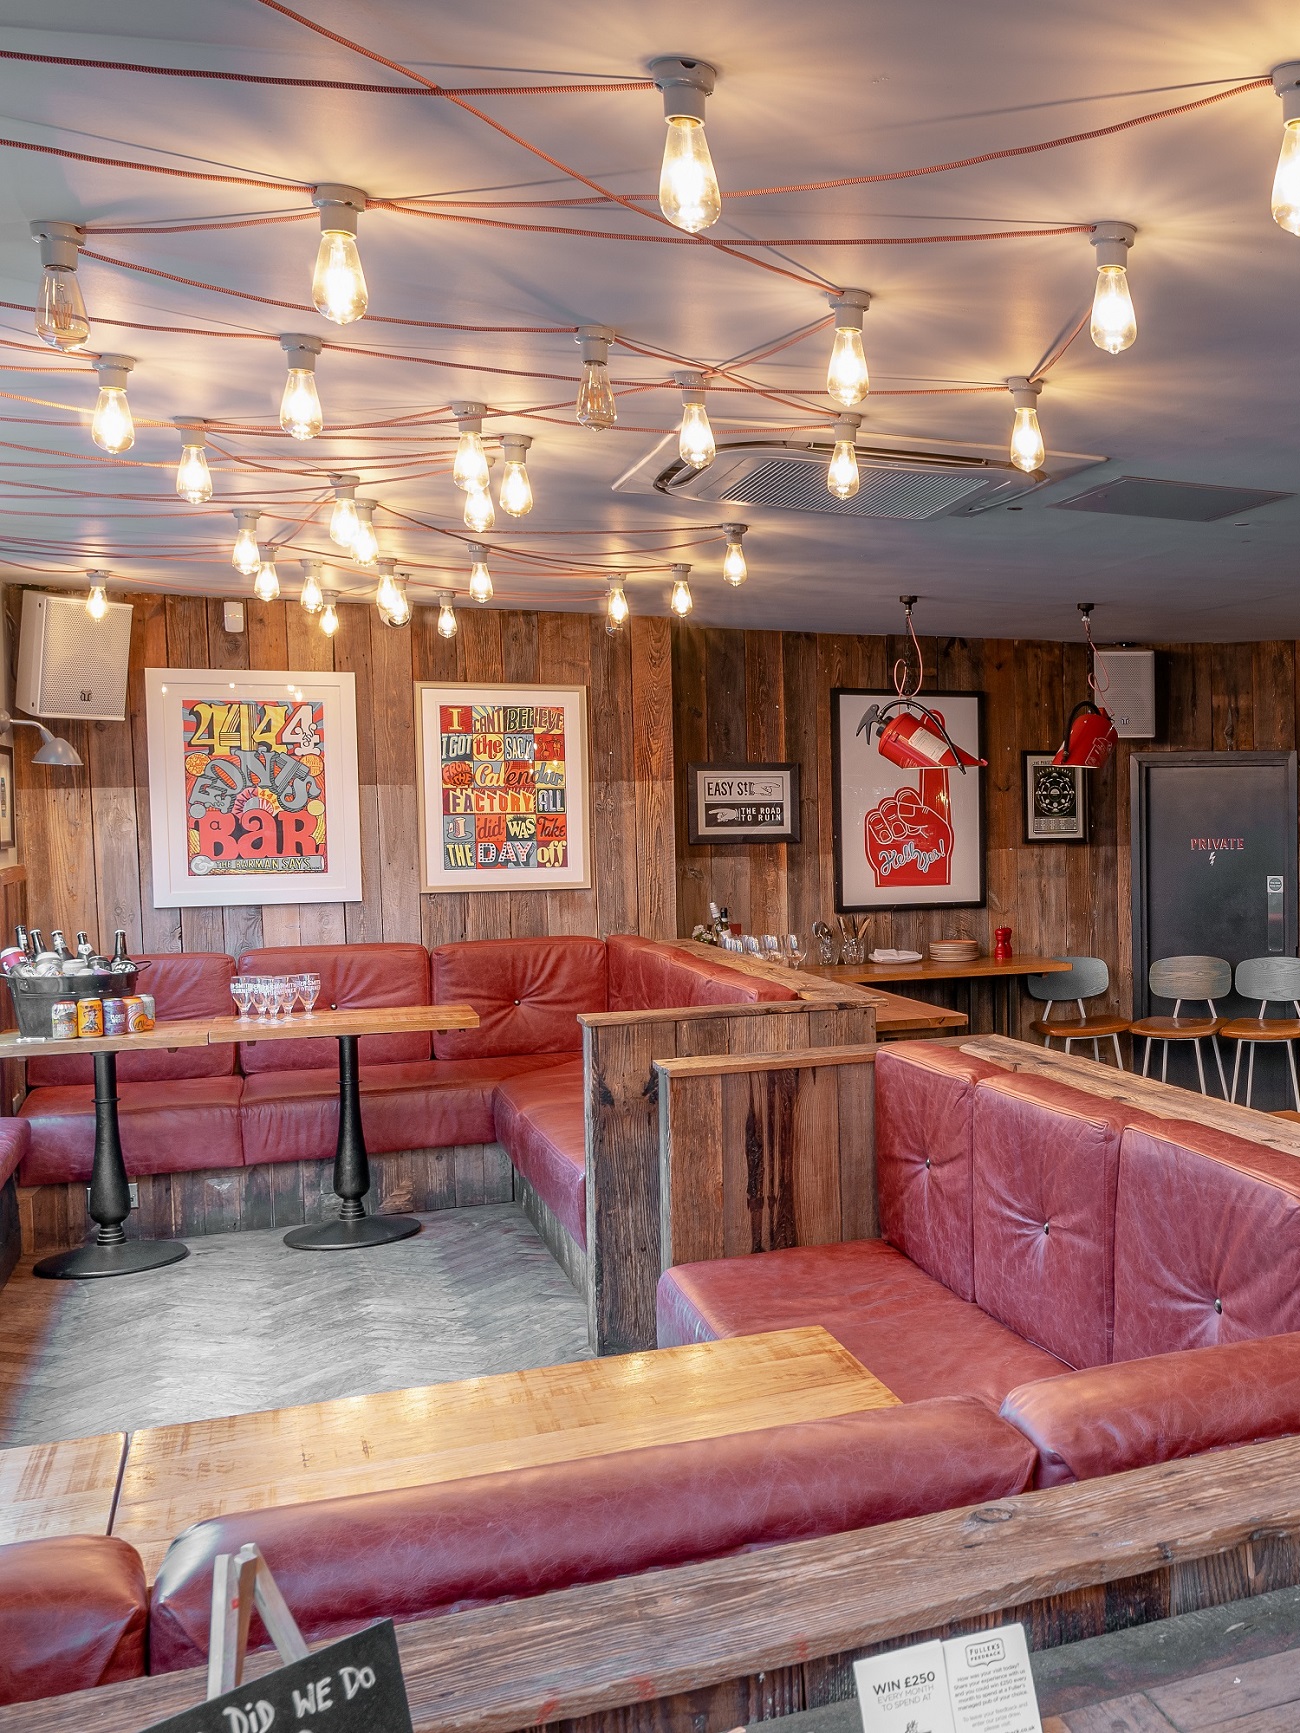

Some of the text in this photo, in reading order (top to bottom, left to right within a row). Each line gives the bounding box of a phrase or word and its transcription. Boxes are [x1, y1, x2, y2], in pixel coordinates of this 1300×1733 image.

[448, 707, 465, 730] I
[505, 706, 564, 731] BELIEVE
[189, 703, 321, 755] 4444
[441, 734, 532, 760] I GOT the SACK
[442, 761, 473, 778] FROM
[188, 750, 322, 813] FONTS
[707, 781, 734, 796] EASY
[235, 788, 258, 815] WALK
[538, 789, 565, 812] ALL
[740, 807, 781, 815] THE ROAD
[740, 814, 753, 822] TO
[209, 820, 222, 831] a
[478, 815, 503, 840] did
[507, 818, 537, 839] WAS
[537, 815, 566, 838] Take
[1190, 838, 1245, 850] PRIVATE
[446, 840, 567, 868] THE DAY off
[879, 838, 946, 876] Hell Yes!
[215, 860, 231, 869] THE
[235, 858, 280, 870] BARMAN
[281, 856, 311, 869] SAYS
[969, 1643, 1001, 1656] FULLER'S
[970, 1651, 1001, 1661] FEEDBACK
[1003, 1663, 1020, 1671] today?
[872, 1671, 936, 1695] WIN £250
[981, 1674, 1007, 1684] experience
[877, 1684, 935, 1705] EVERY MONTH
[958, 1695, 975, 1703] month
[982, 1690, 997, 1698] spend
[1008, 1683, 1026, 1691] Fuller's
[975, 1684, 989, 1692] could
[292, 1676, 334, 1718] WE
[881, 1694, 932, 1712] TO SPEND AT
[957, 1700, 982, 1711] managed
[982, 1697, 992, 1705] pub
[999, 1694, 1010, 1702] your
[983, 1710, 994, 1718] your
